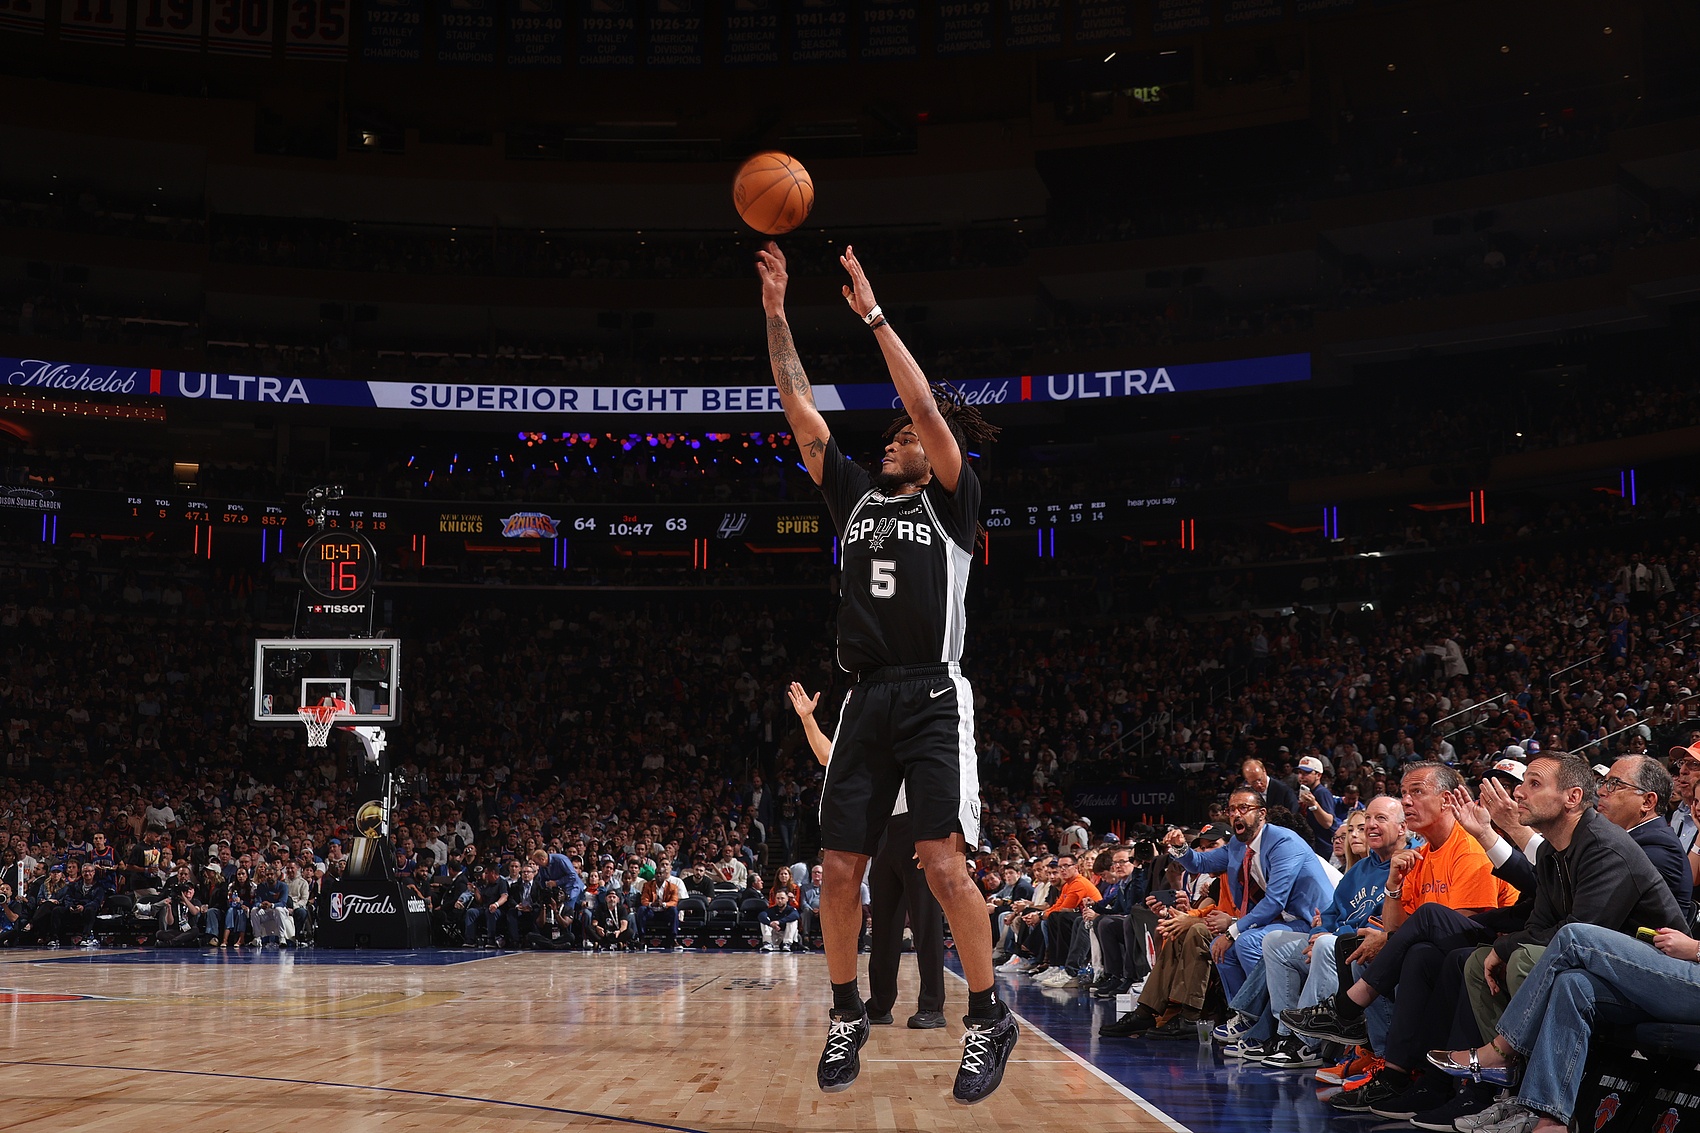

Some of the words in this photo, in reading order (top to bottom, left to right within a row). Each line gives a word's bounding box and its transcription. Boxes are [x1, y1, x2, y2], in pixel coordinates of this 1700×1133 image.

[863, 8, 915, 23] 1989-90
[940, 2, 990, 17] 1991-92
[1080, 5, 1126, 18] ATLANTIC
[1162, 7, 1201, 21] SEASON
[1224, 6, 1282, 23] CHAMPIONS
[215, 0, 268, 36] 30
[290, 0, 346, 40] 35
[367, 10, 420, 24] 1927-28
[441, 14, 494, 27] 1932-33
[727, 15, 777, 29] 1931-32
[795, 11, 846, 26] 1941-42
[1010, 11, 1056, 25] REGULAR
[511, 18, 562, 30] 1939-40
[582, 18, 634, 30] 1993-94
[650, 18, 700, 30] 1926-27
[869, 24, 908, 35] PATRICK
[944, 18, 983, 30] PATRICK
[1014, 23, 1053, 36] SEASON
[1083, 17, 1124, 30] DIVISION
[1153, 16, 1210, 33] CHAMPIONS
[371, 26, 413, 37] STANLEY
[446, 30, 488, 41] STANLEY
[727, 31, 775, 41] AMERICAN
[798, 27, 842, 39] REGULAR
[944, 30, 984, 42] DIVISION
[1075, 27, 1132, 41] CHAMPIONS
[382, 37, 402, 47] CUP
[514, 33, 556, 43] STANLEY
[586, 34, 628, 43] STANLEY
[650, 34, 698, 43] AMERICAN
[801, 39, 839, 49] SEASON
[869, 35, 909, 46] DIVISION
[1005, 33, 1061, 47] CHAMPIONS
[456, 41, 476, 51] CUP
[525, 44, 545, 54] CUP
[597, 44, 617, 54] CUP
[654, 44, 694, 54] DIVISION
[731, 42, 770, 53] DIVISION
[861, 46, 916, 57] CHAMPIONS
[937, 40, 991, 53] CHAMPIONS
[363, 48, 420, 59] CHAMPIONS
[438, 51, 494, 62] CHAMPIONS
[724, 52, 778, 64] CHAMPIONS
[792, 49, 847, 61] CHAMPIONS
[507, 55, 562, 65] CHAMPIONS
[579, 55, 634, 65] CHAMPIONS
[646, 55, 701, 65] CHAMPIONS
[7, 358, 138, 394] Michelob
[178, 371, 310, 404] ULTRA
[1047, 367, 1176, 401] ULTRA
[410, 384, 578, 411] SUPERIOR
[593, 388, 688, 412] LIGHT
[702, 388, 783, 410] BEER
[0, 497, 15, 505] DISON
[16, 497, 38, 508] SQUARE
[39, 499, 62, 509] GARDEN
[187, 502, 208, 510] 3PT%
[266, 506, 282, 514] FT%
[1127, 498, 1145, 507] hear
[1146, 499, 1161, 507] you
[1162, 497, 1178, 506] say.
[990, 508, 1006, 516] FT%
[1091, 501, 1106, 509] REB
[132, 507, 139, 517] 1
[158, 509, 167, 519] 5
[184, 511, 210, 522] 47.1
[222, 513, 249, 524] 57.9
[261, 515, 288, 526] 85.7
[440, 513, 460, 521] NEW
[460, 513, 483, 521] YORK
[622, 514, 637, 522] 3rd
[986, 517, 1012, 528] 60.0
[1028, 516, 1036, 525] 5
[1049, 514, 1058, 524] 4
[1069, 513, 1083, 523] 19
[1091, 511, 1105, 521] 14
[372, 521, 387, 530] 18
[439, 521, 484, 533] KNICKS
[505, 514, 555, 533] KNICKS
[574, 517, 596, 531] 64
[608, 523, 654, 536] 10:47
[665, 518, 688, 531] 63
[776, 520, 819, 534] SPURS
[847, 517, 932, 549] SPURS
[320, 543, 361, 561] 10:47
[330, 561, 357, 591] 16
[869, 558, 897, 600] 5
[323, 604, 365, 613] TISSOT
[1072, 793, 1118, 808] Michelob
[1131, 792, 1175, 806] ULTRA
[1349, 887, 1367, 909] FEAR
[335, 894, 397, 922] Finals
